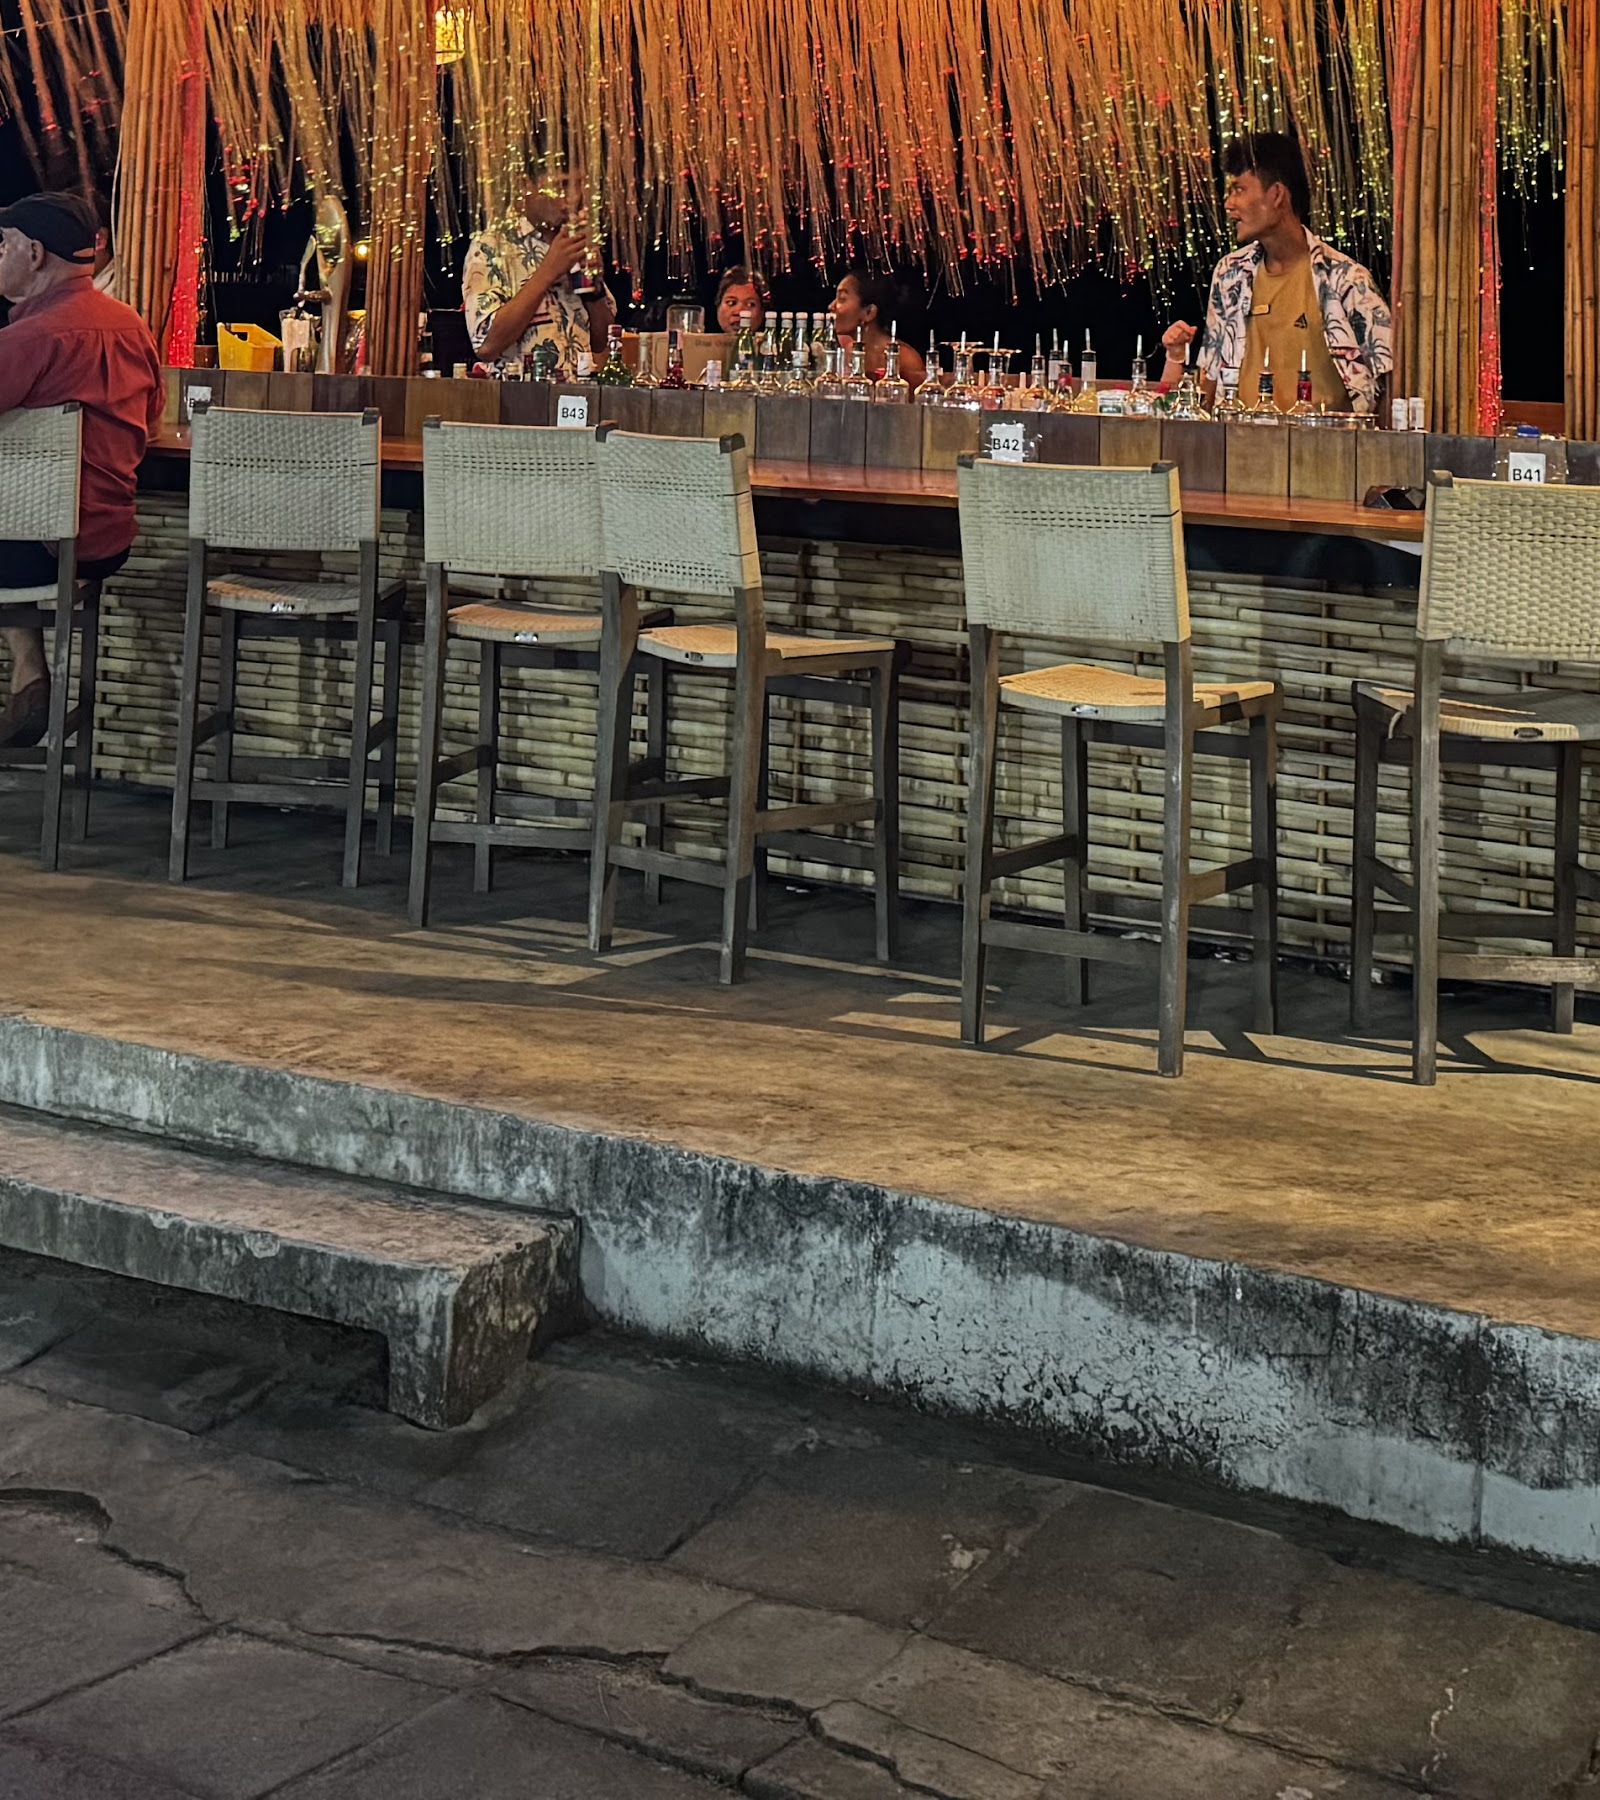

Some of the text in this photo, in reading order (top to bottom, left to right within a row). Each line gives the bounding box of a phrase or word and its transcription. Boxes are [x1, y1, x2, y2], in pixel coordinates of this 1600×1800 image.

[561, 407, 585, 420] B43
[993, 438, 1020, 451] B42
[1512, 468, 1541, 482] B41
